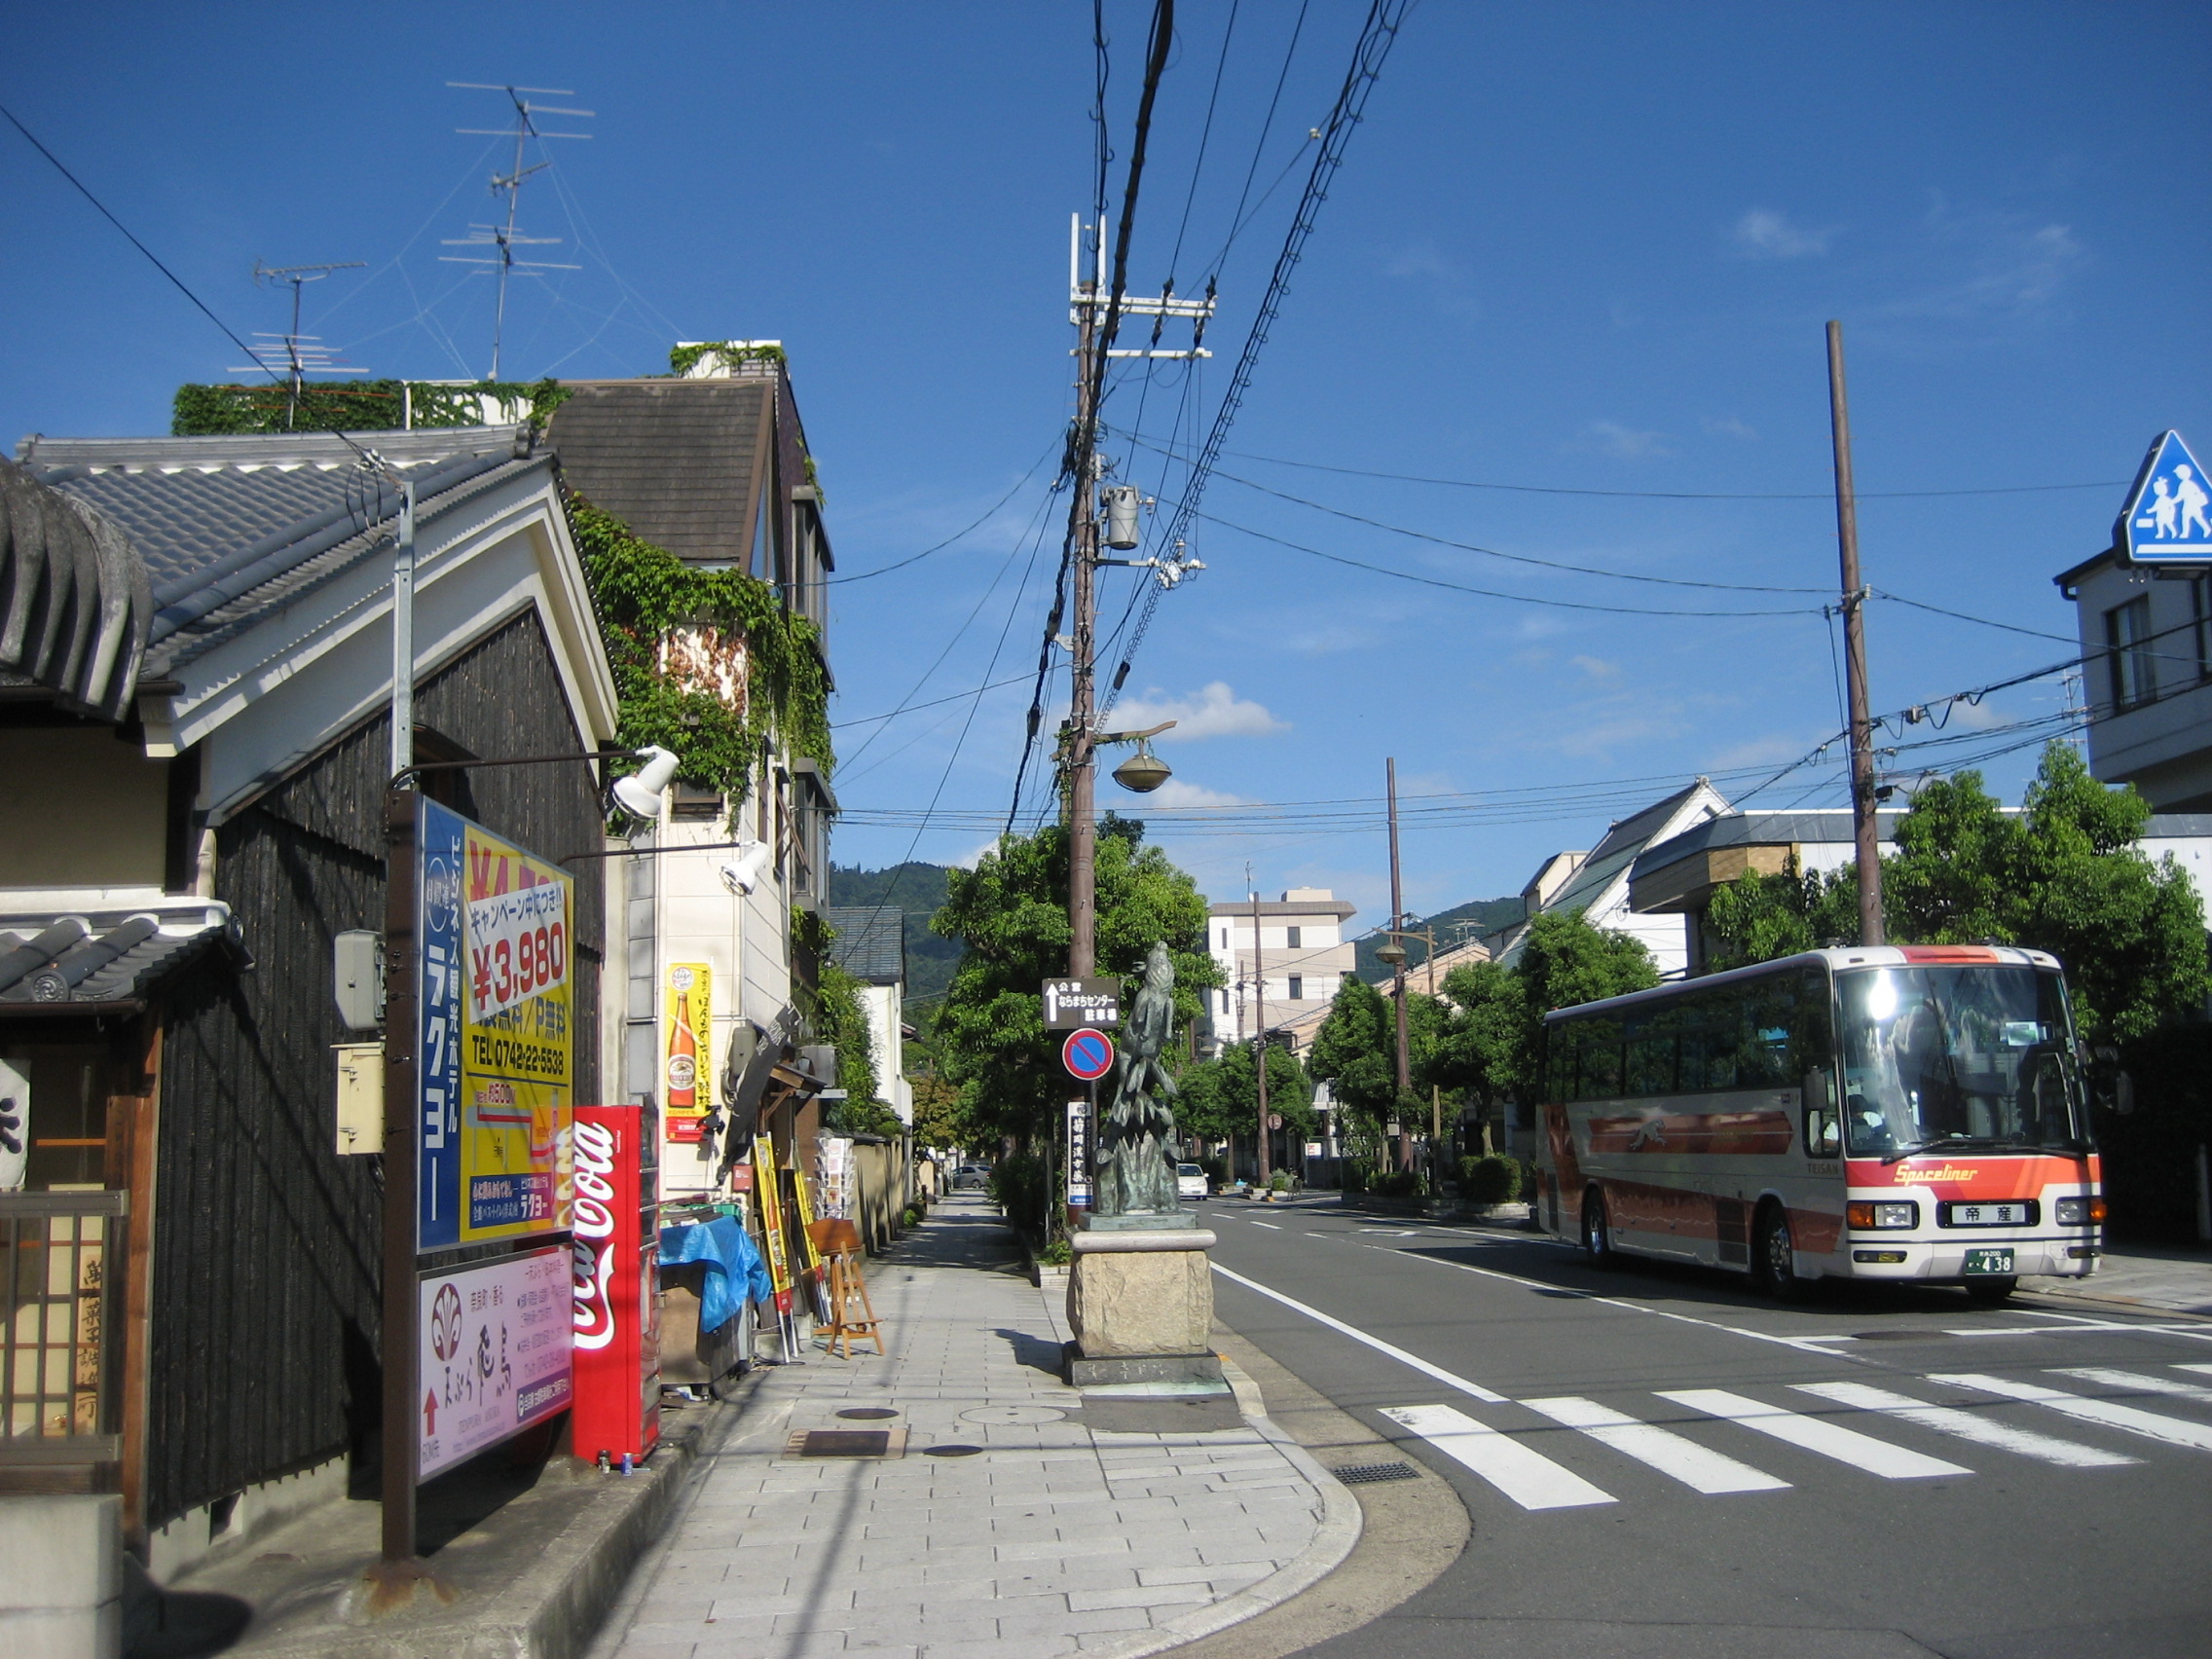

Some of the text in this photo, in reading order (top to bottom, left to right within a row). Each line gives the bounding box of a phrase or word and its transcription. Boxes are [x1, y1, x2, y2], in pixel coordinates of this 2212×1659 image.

[472, 922, 563, 1011] ¥3,980
[1058, 981, 1082, 992] 公営
[1058, 994, 1116, 1008] ならまちセンター
[1085, 1008, 1118, 1021] 駐車場
[472, 1035, 493, 1065] TEL
[424, 944, 446, 1222] ラクヨー
[1894, 1163, 1978, 1186] Spaceliner
[1965, 1206, 2012, 1223] 帝産
